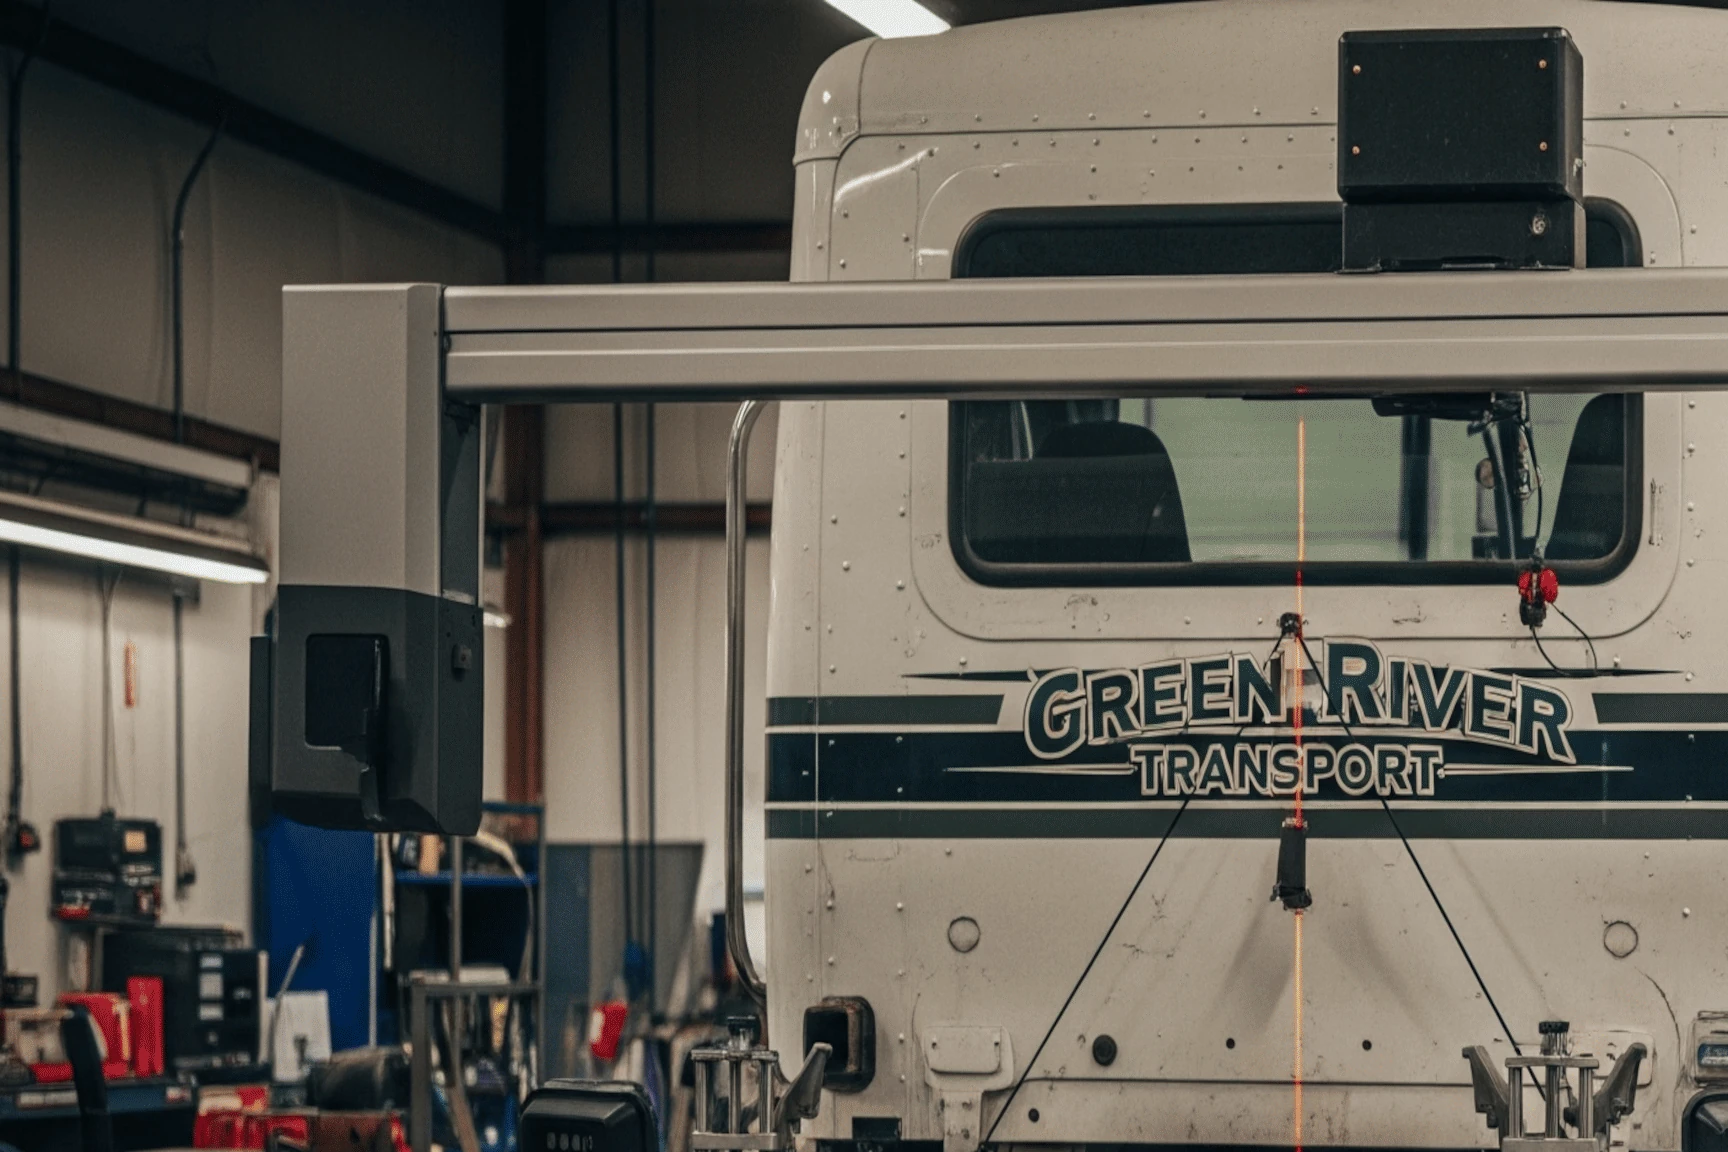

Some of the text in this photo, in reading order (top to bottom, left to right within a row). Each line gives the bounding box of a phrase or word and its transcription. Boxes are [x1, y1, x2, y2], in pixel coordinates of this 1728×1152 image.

[1024, 636, 1577, 764] GREEN RIVER
[1130, 744, 1444, 796] TRANSPORT
